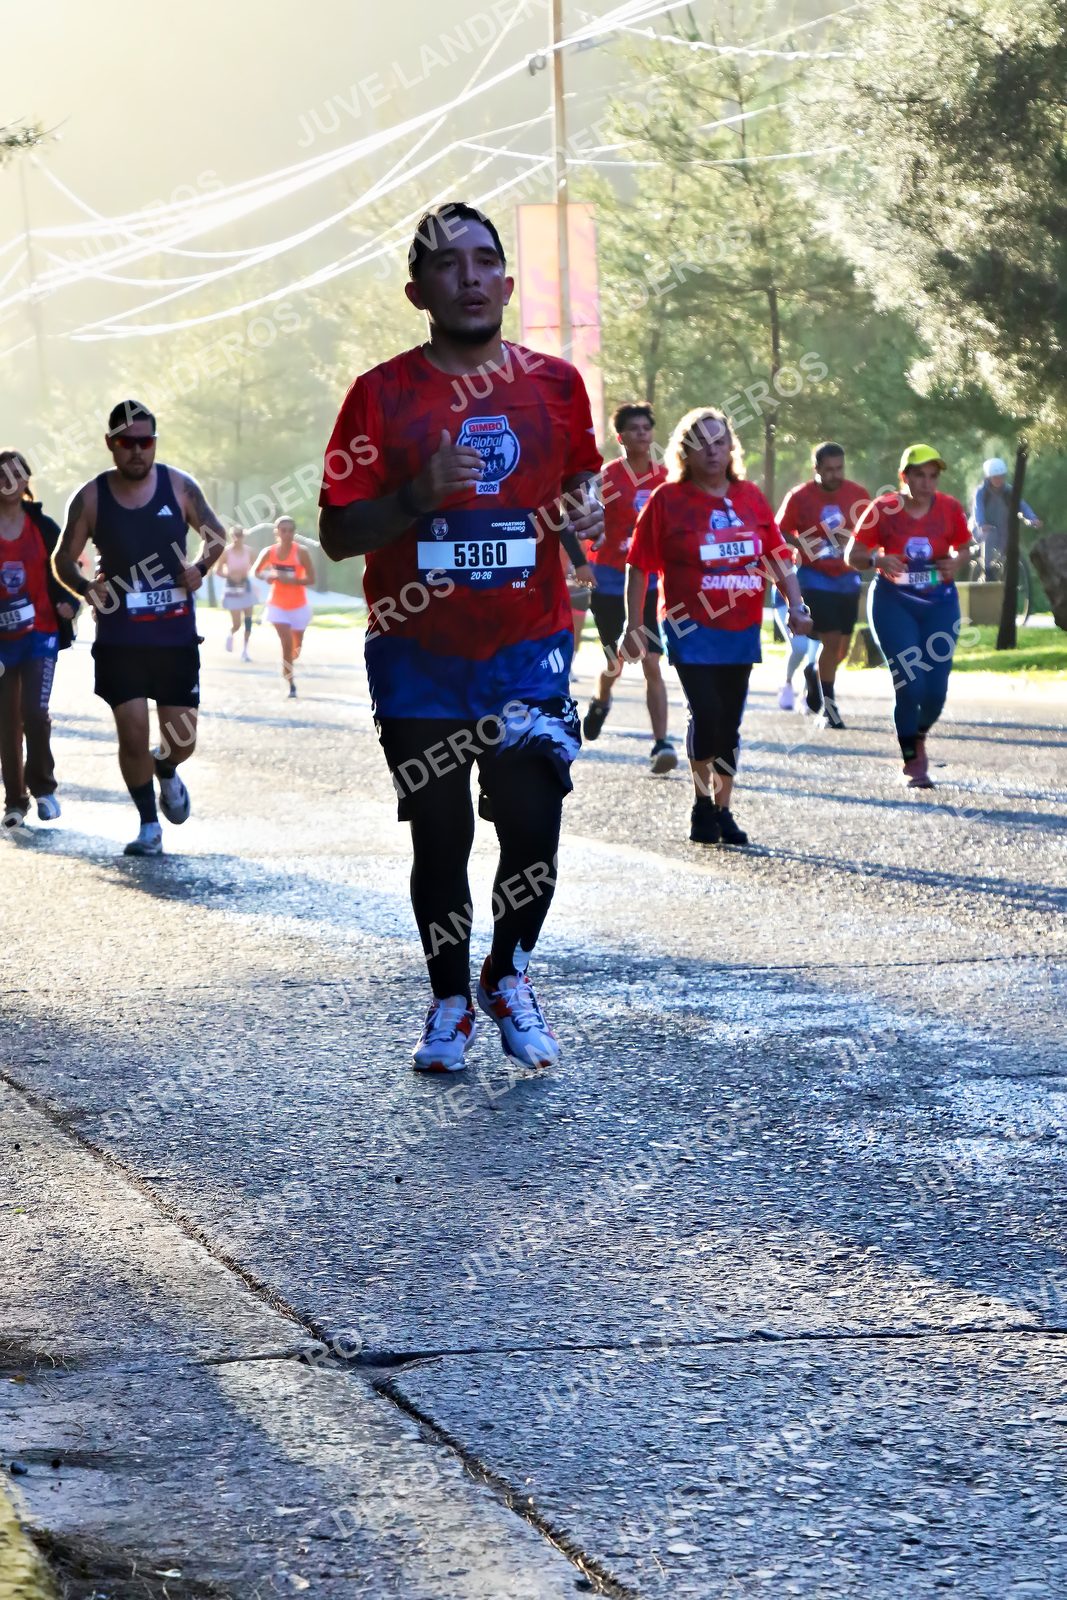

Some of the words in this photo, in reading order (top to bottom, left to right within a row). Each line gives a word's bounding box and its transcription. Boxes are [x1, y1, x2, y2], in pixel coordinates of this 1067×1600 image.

[468, 422, 503, 433] BIMBO
[470, 434, 503, 448] Global
[478, 484, 498, 493] 2026
[453, 541, 508, 568] 5360
[719, 542, 746, 557] 3434
[511, 581, 526, 589] 10K
[146, 590, 173, 605] 5248
